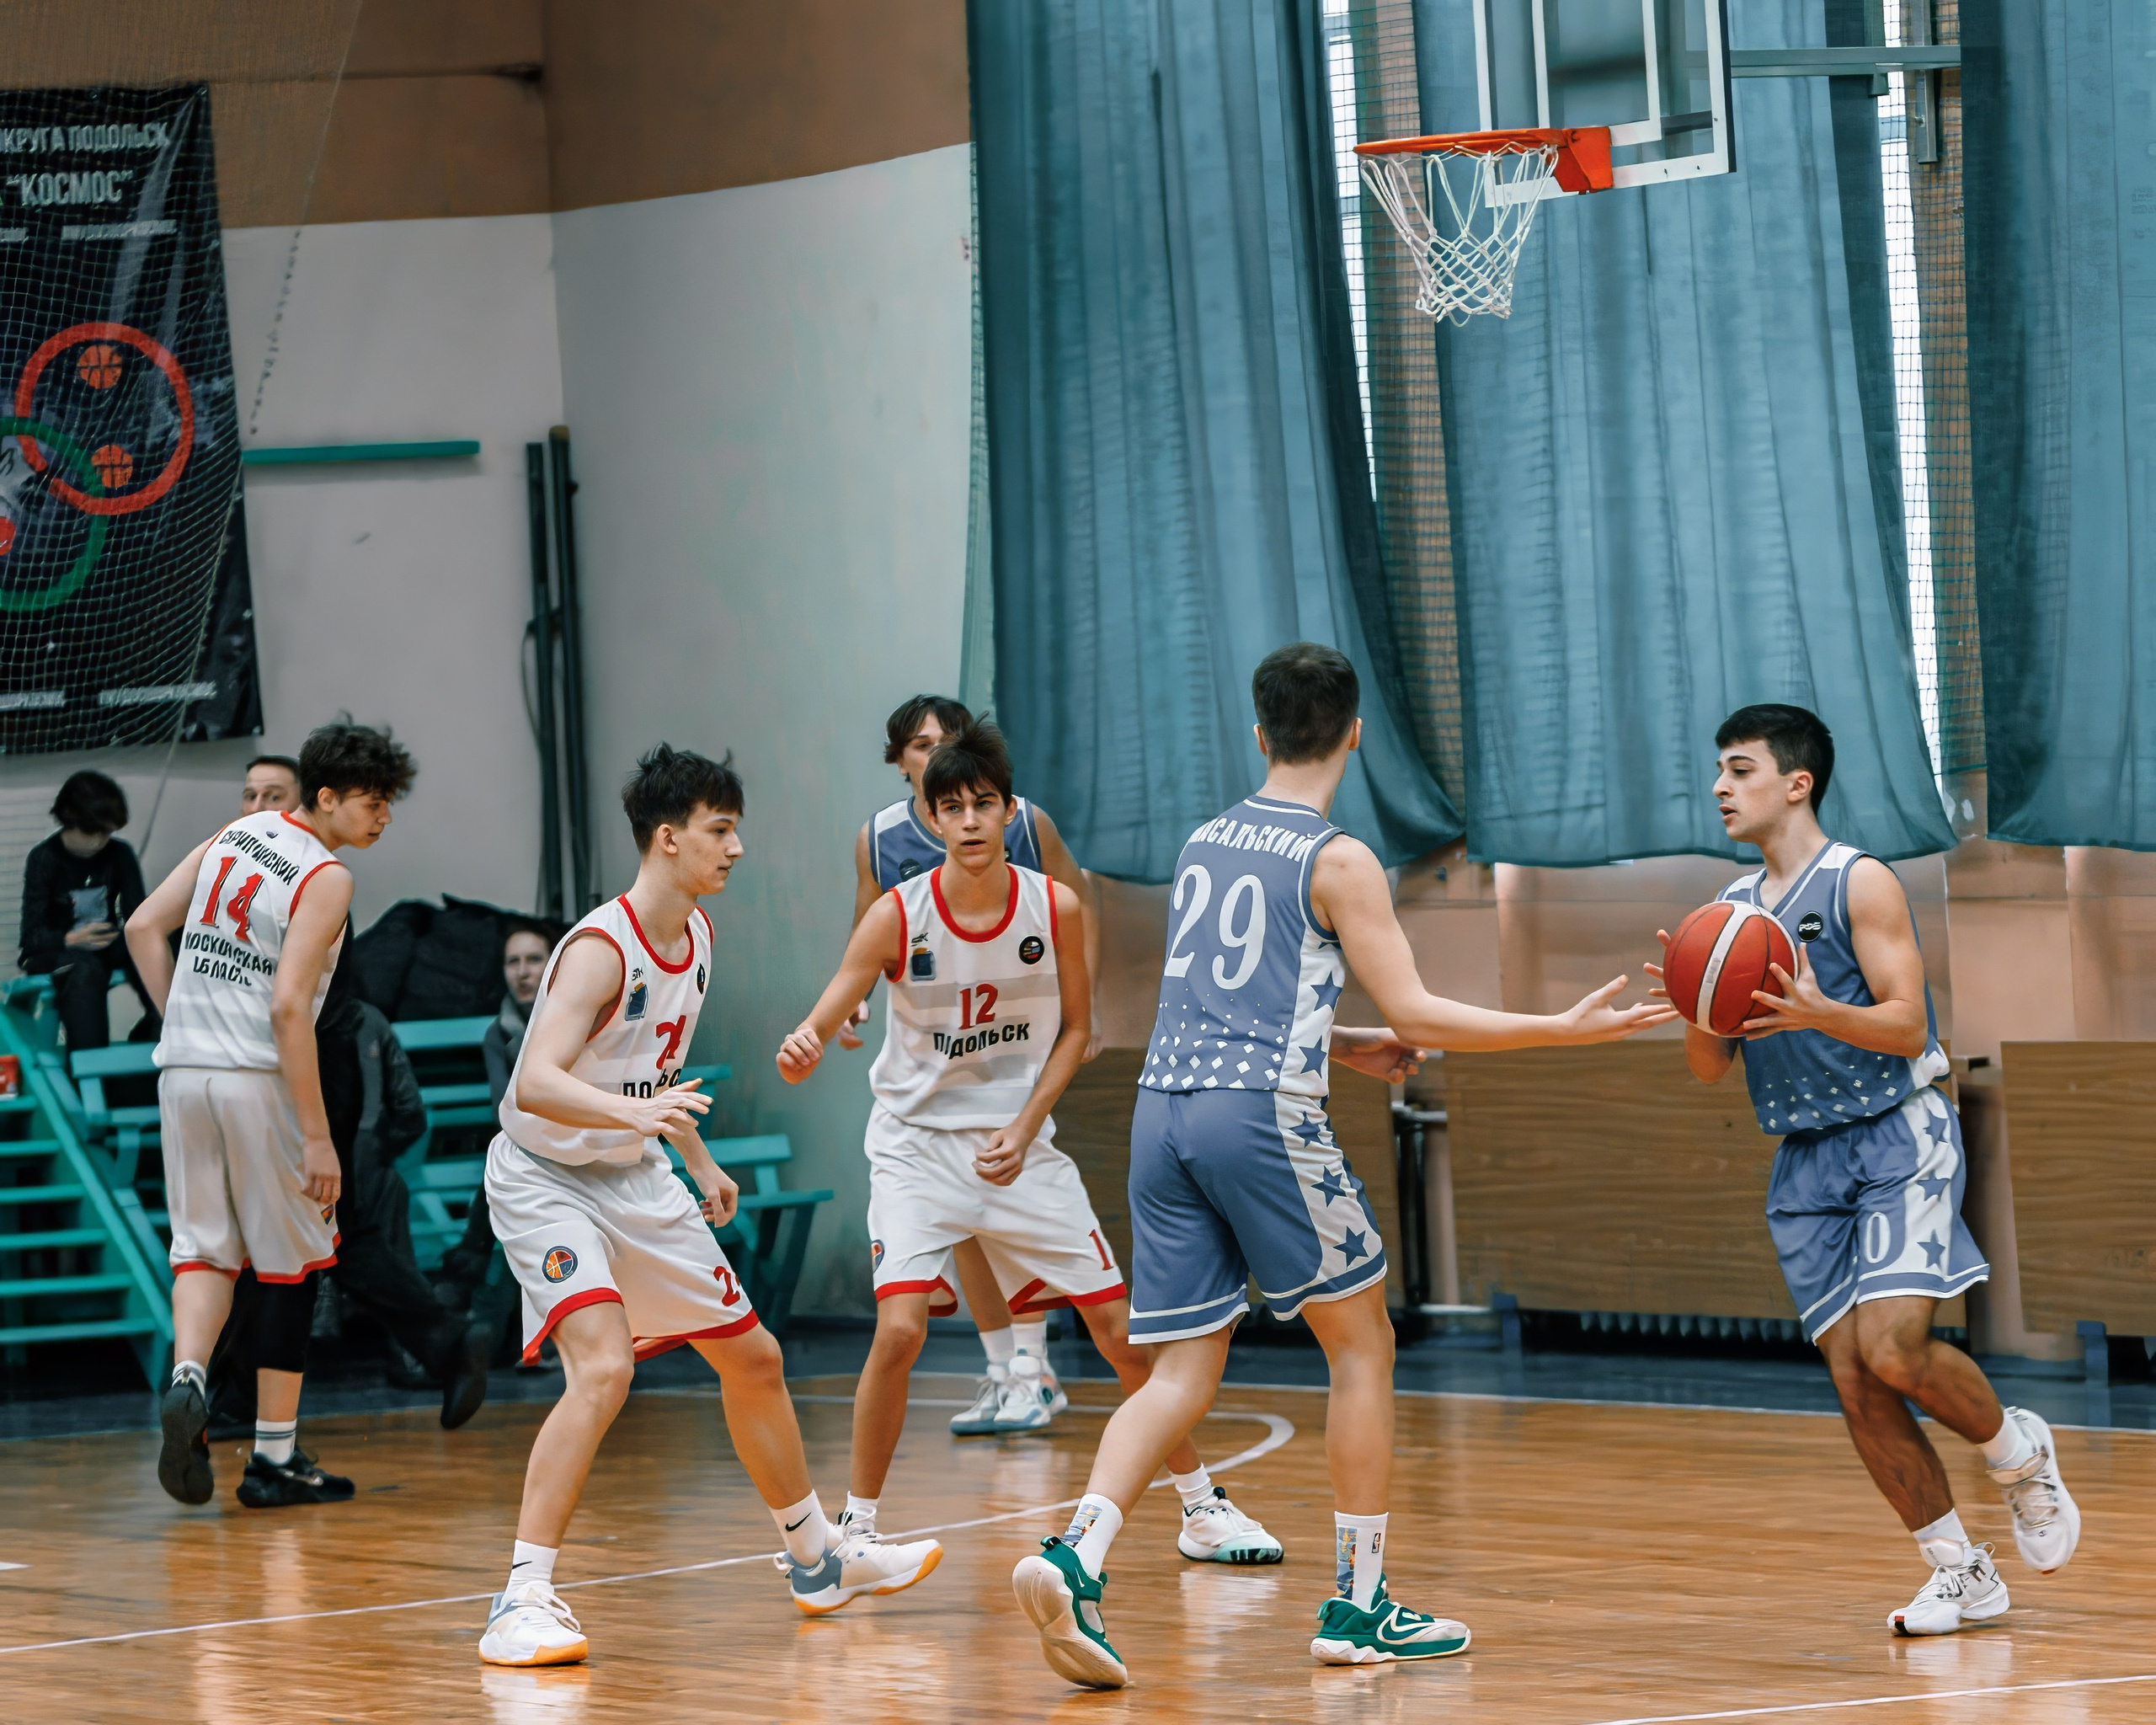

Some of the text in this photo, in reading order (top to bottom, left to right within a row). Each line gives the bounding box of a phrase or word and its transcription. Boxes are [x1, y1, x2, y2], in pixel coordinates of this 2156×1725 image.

[199, 856, 265, 944] 14
[1163, 864, 1267, 991] 29
[958, 983, 998, 1030] 12
[1853, 1211, 1892, 1263] 0
[712, 1265, 741, 1307] 2
